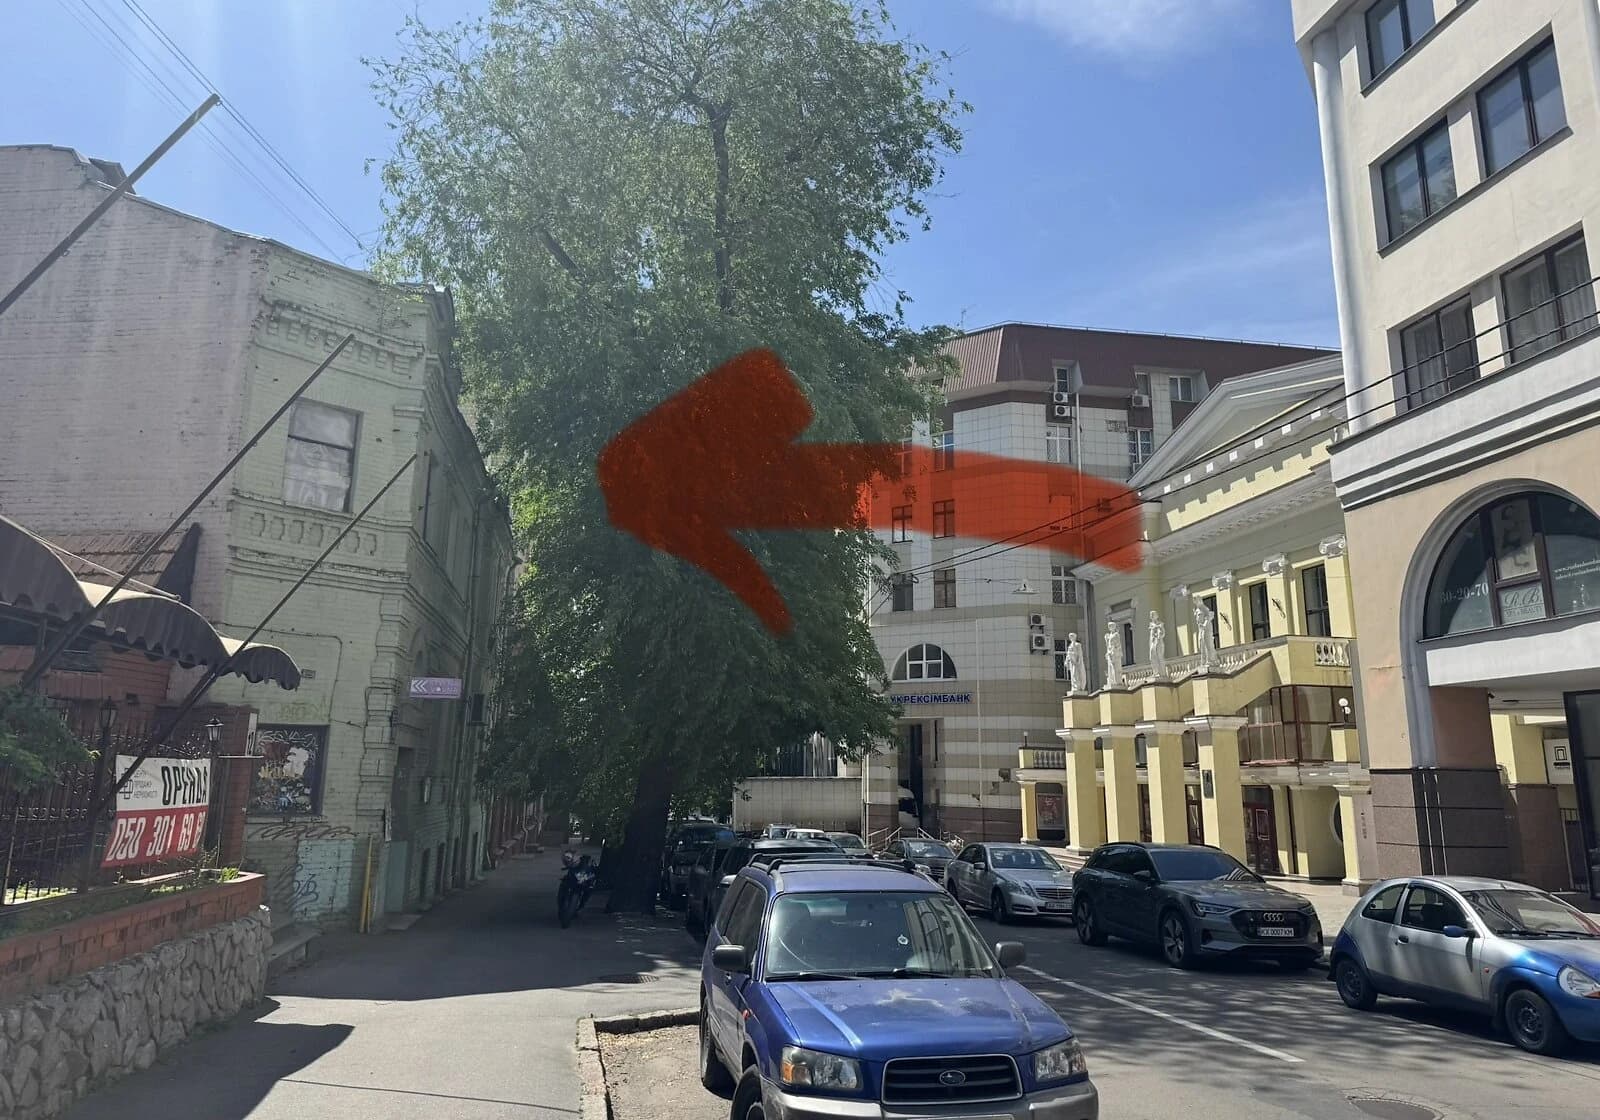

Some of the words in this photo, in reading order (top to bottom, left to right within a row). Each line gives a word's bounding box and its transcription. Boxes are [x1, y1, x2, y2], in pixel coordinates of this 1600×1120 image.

[161, 766, 207, 806] ОРЕНДА
[105, 817, 146, 861] 050
[146, 814, 176, 857] 301
[177, 813, 195, 853] 69
